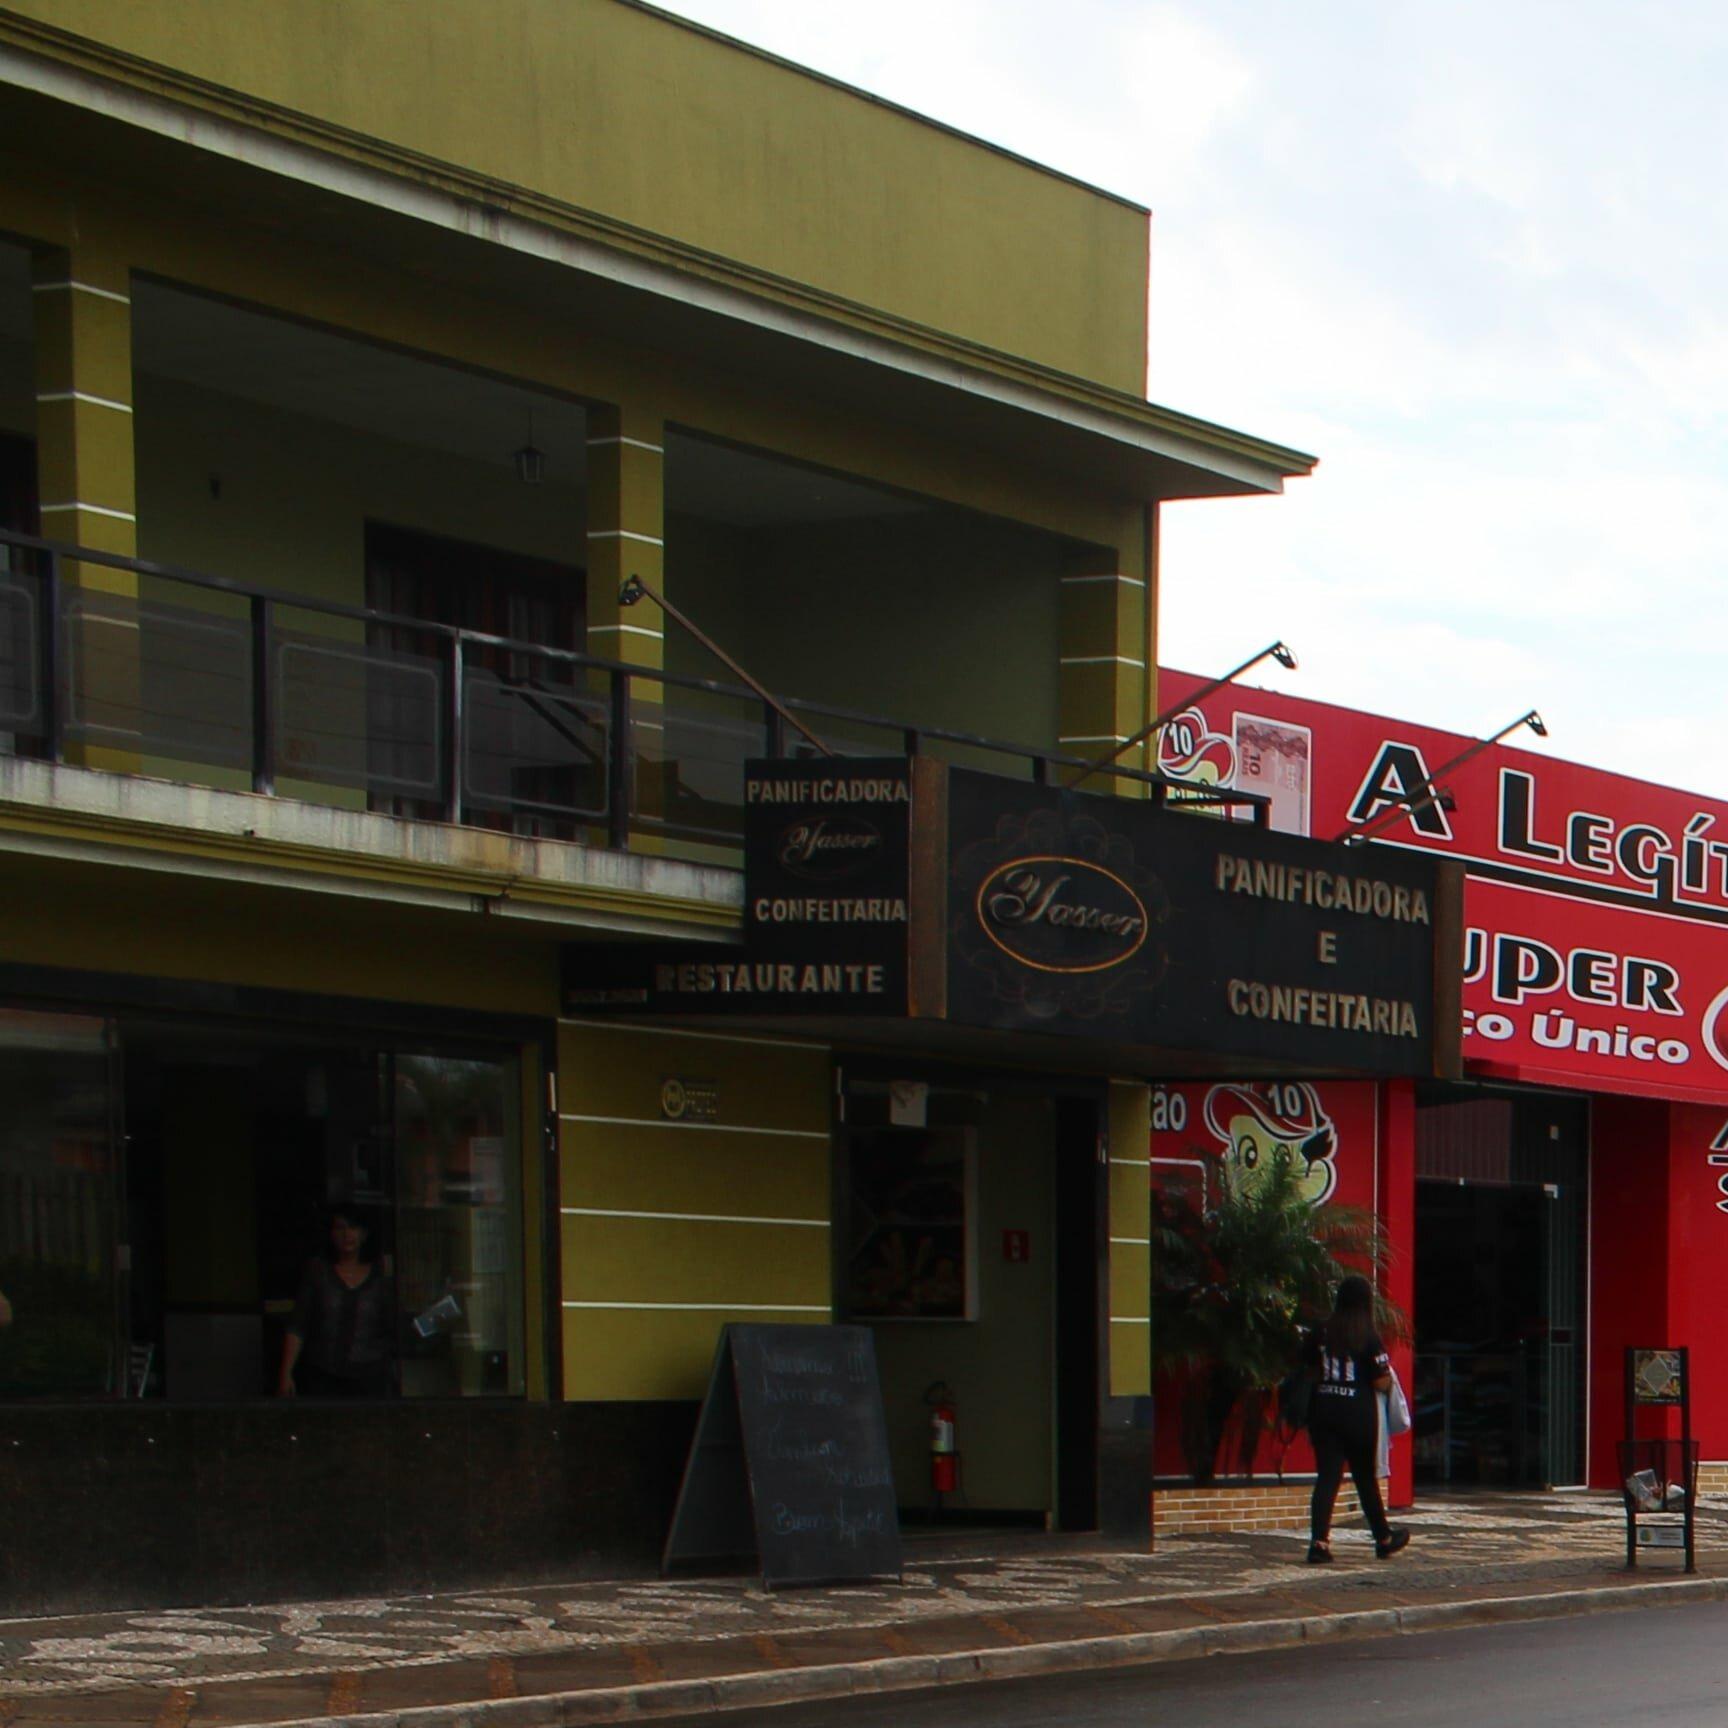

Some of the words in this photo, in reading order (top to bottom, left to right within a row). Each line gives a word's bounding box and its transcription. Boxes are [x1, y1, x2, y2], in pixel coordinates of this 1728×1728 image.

[1169, 722, 1193, 757] 10
[746, 779, 910, 803] PANIFICADORA
[1346, 740, 1453, 841] A
[1217, 853, 1430, 926] PANIFICADORA
[755, 897, 907, 922] CONFEITARIA
[1319, 931, 1338, 964] E
[656, 962, 886, 994] RESTAURANTE
[1228, 978, 1418, 1039] CONFEITARIA
[1530, 1008, 1691, 1065] Único
